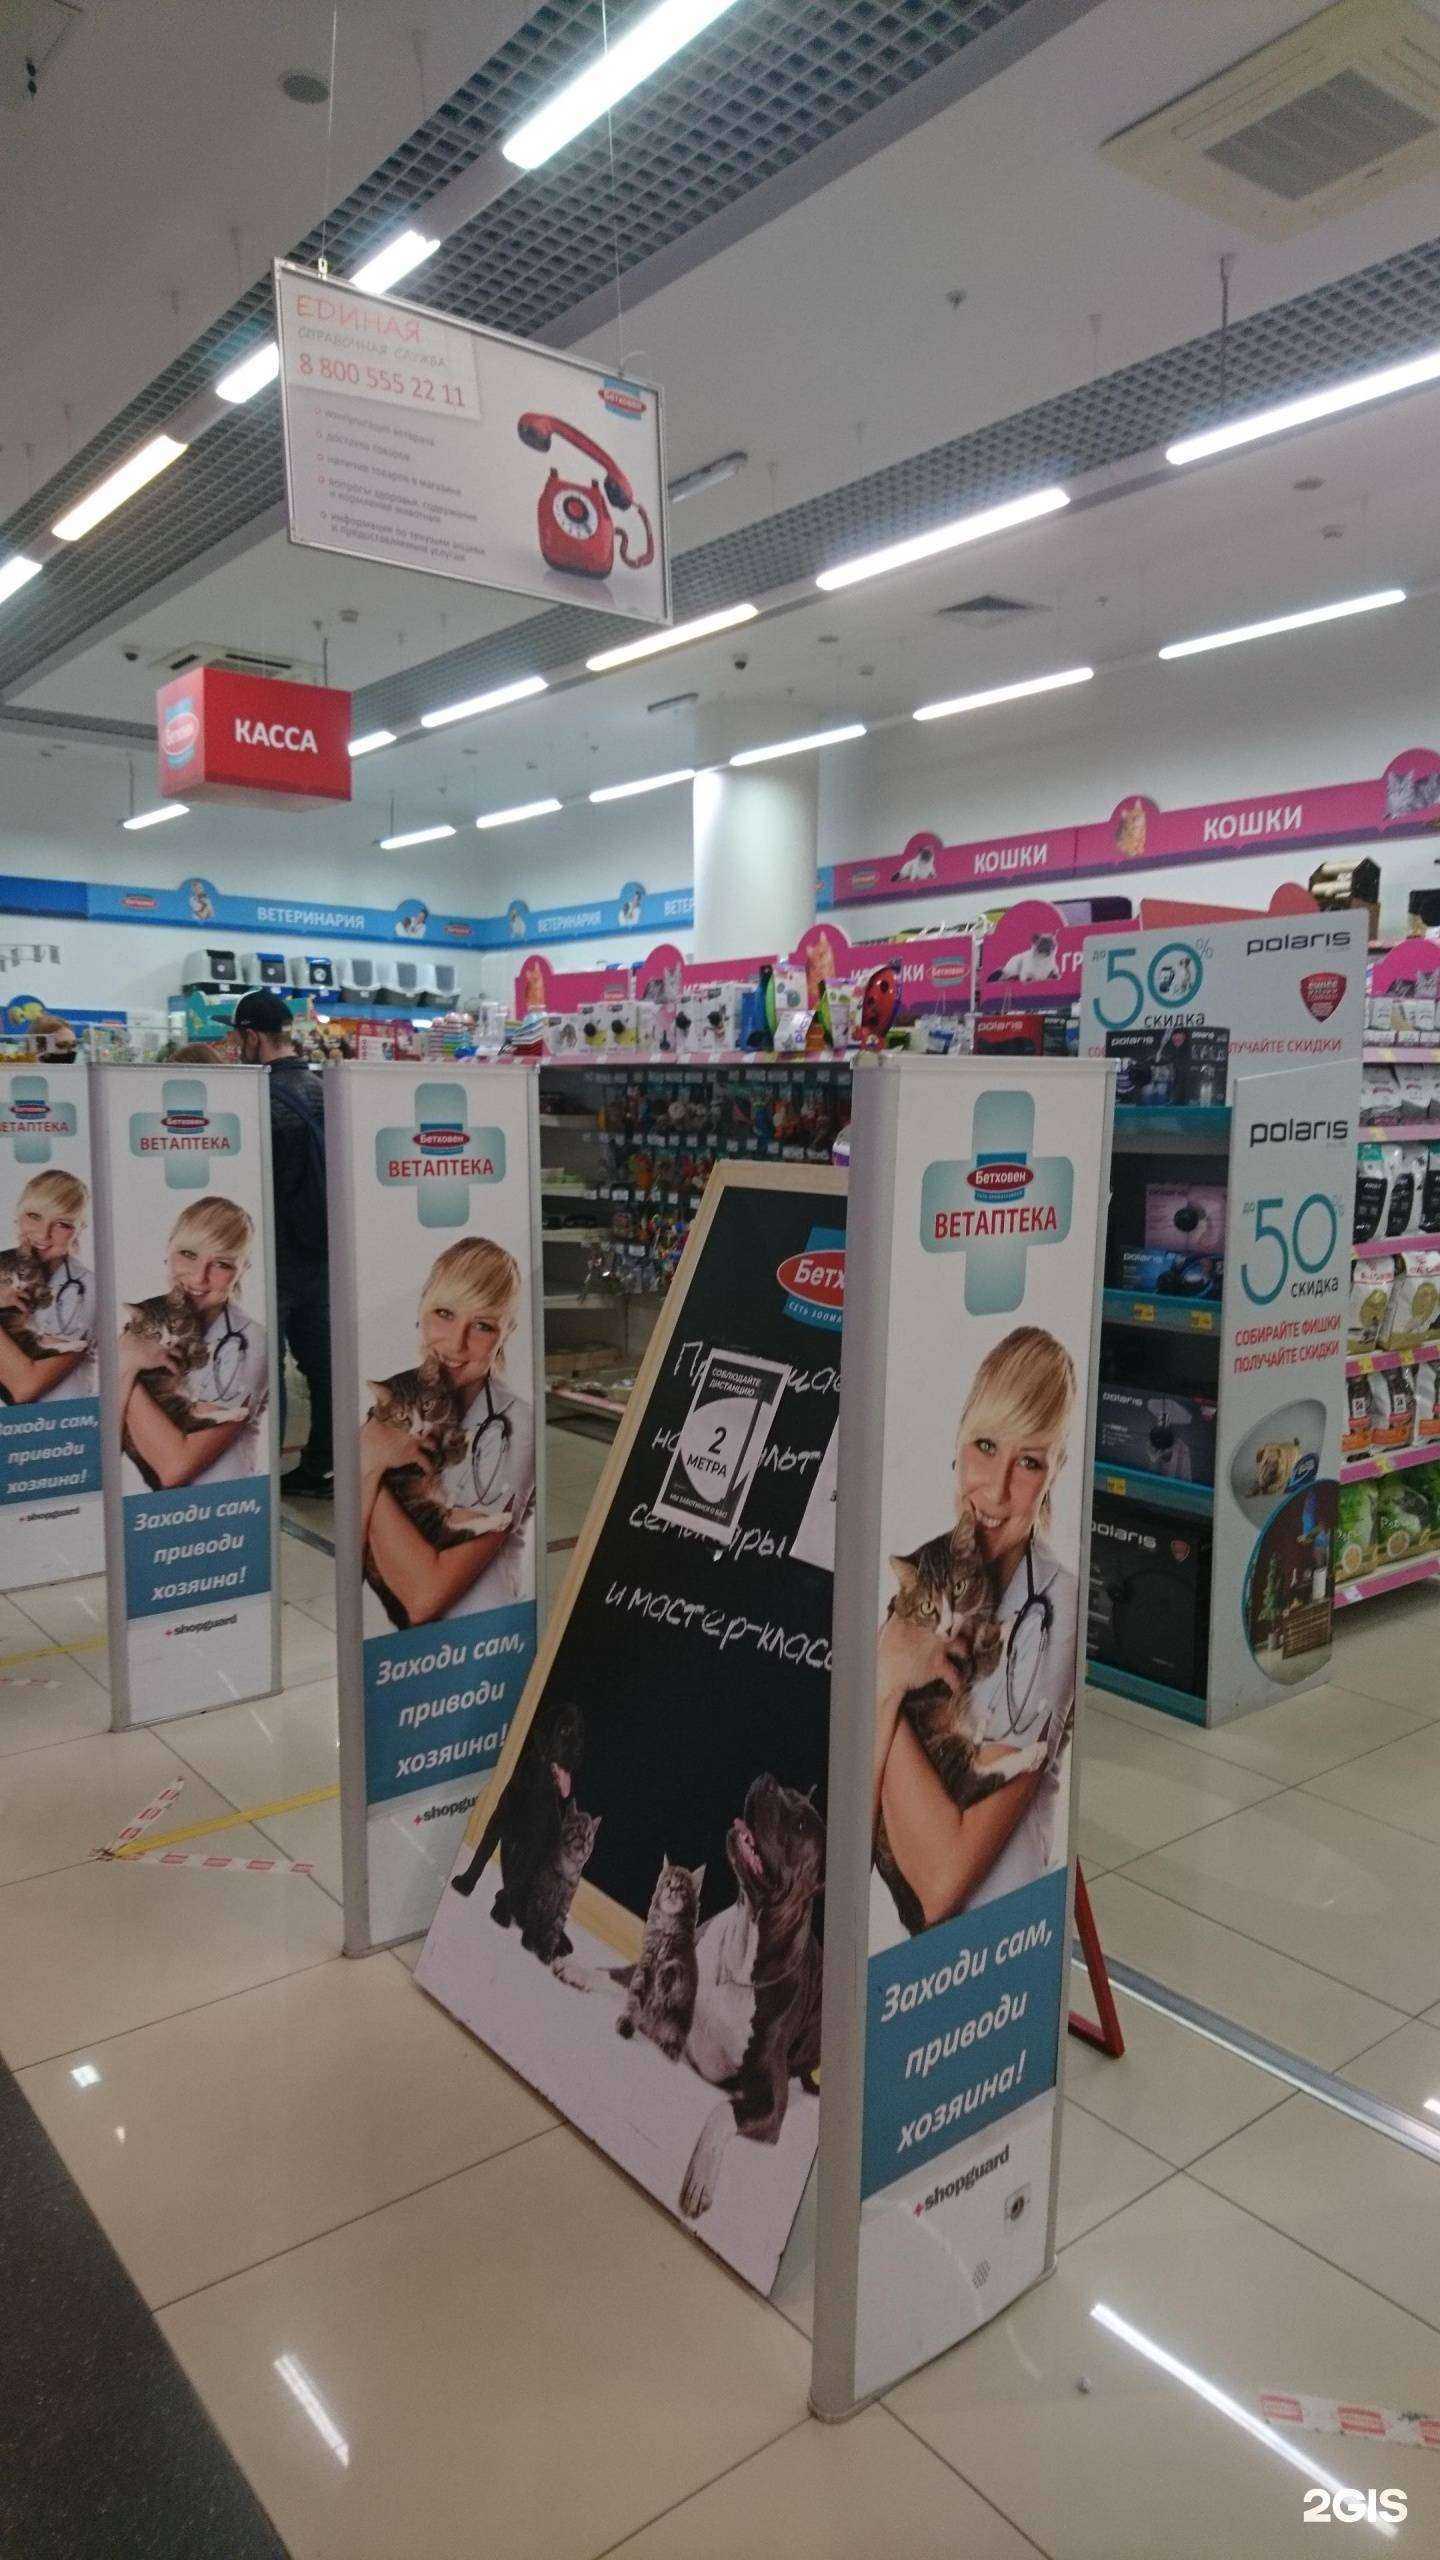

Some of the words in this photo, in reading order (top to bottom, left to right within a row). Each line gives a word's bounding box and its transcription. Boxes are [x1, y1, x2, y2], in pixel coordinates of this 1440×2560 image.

[298, 326, 388, 355] СПРАВОЧНАЯ
[299, 352, 314, 375] 8
[319, 357, 361, 384] 800
[366, 365, 405, 395] 555
[410, 376, 436, 402] 22
[441, 383, 466, 407] 11
[234, 718, 318, 754] КАССА
[1203, 804, 1304, 842] КОШКИ
[973, 843, 1048, 875] КОШКИ
[257, 905, 365, 930] ВЕТЕРИНАРИЯ
[538, 911, 601, 933] ВЕТЕРИНАРИЯ
[1246, 928, 1352, 956] polaris
[1144, 1013, 1206, 1029] скидка
[1111, 1035, 1155, 1047] polaris
[1287, 1038, 1343, 1055] СКИДКИ
[0, 1121, 70, 1133] ЕТАПТЕКА
[1250, 1119, 1349, 1147] polaris
[140, 1137, 231, 1151] ВЕТАПТЕКА
[388, 1158, 494, 1178] ВЕТАПТЕКА
[976, 1170, 1026, 1184] Бетховен
[934, 1206, 1058, 1239] ВЕТАПТЕКА
[794, 1258, 847, 1290] Бетх
[1291, 1277, 1339, 1298] скидка
[1235, 1320, 1300, 1346] СОБИРАЙТЕ
[1301, 1314, 1342, 1335] ФИШКИ
[1234, 1347, 1297, 1373] ПОЛУЧАЙТЕ
[1299, 1340, 1340, 1361] СКИДКИ
[709, 1379, 755, 1397] ДИСТАНЦИЮ
[712, 1367, 762, 1388] СОБЛЮДАЙТЕ
[0, 1417, 55, 1436] аходи
[60, 1414, 98, 1430] сам,
[7, 1441, 85, 1466] приводи
[707, 1426, 728, 1455] 2
[686, 1453, 728, 1478] МЕТРА
[6, 1469, 87, 1494] хозяина!
[133, 1503, 210, 1531] Заходи
[216, 1499, 262, 1517] сам,
[153, 1534, 245, 1565] приводи
[151, 1566, 247, 1601] хозяина!
[174, 1614, 238, 1636] shopguard
[376, 1644, 466, 1686] Заходи
[473, 1633, 526, 1658] сам,
[398, 1681, 505, 1727] приводи
[395, 1723, 509, 1779] хозяина!
[880, 1947, 988, 2023] Заходи
[995, 1919, 1053, 1966] сам,
[905, 1991, 1028, 2080] приводи
[898, 2050, 1028, 2154] хозяина!
[924, 2144, 1010, 2211] shopguard
